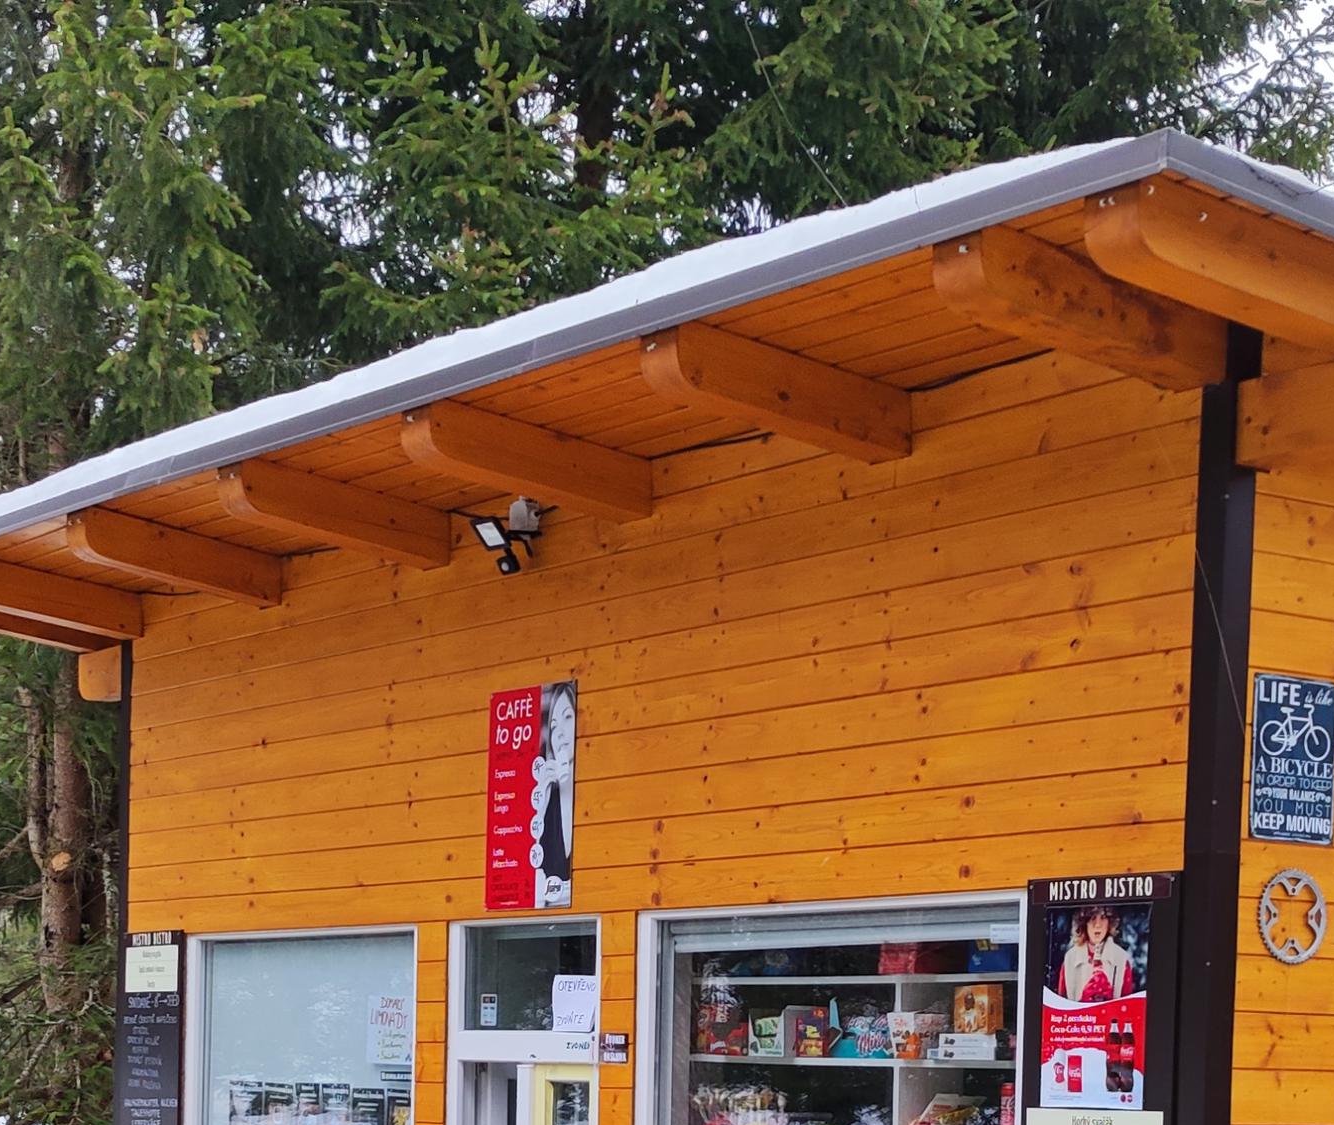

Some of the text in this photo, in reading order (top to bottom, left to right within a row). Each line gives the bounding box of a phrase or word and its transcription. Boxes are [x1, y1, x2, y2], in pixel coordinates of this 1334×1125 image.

[1259, 680, 1333, 707] LIFE is like
[496, 693, 534, 721] CAFFÈ
[495, 724, 532, 750] to go
[1256, 755, 1333, 779] A BICYCLE
[1255, 774, 1265, 785] IN
[1267, 774, 1297, 787] ORDER
[1298, 777, 1311, 789] TO
[1255, 798, 1331, 818] YOU MUST
[1254, 811, 1331, 835] KEEP MOVING
[1049, 876, 1153, 901] MISTRO BISTRO
